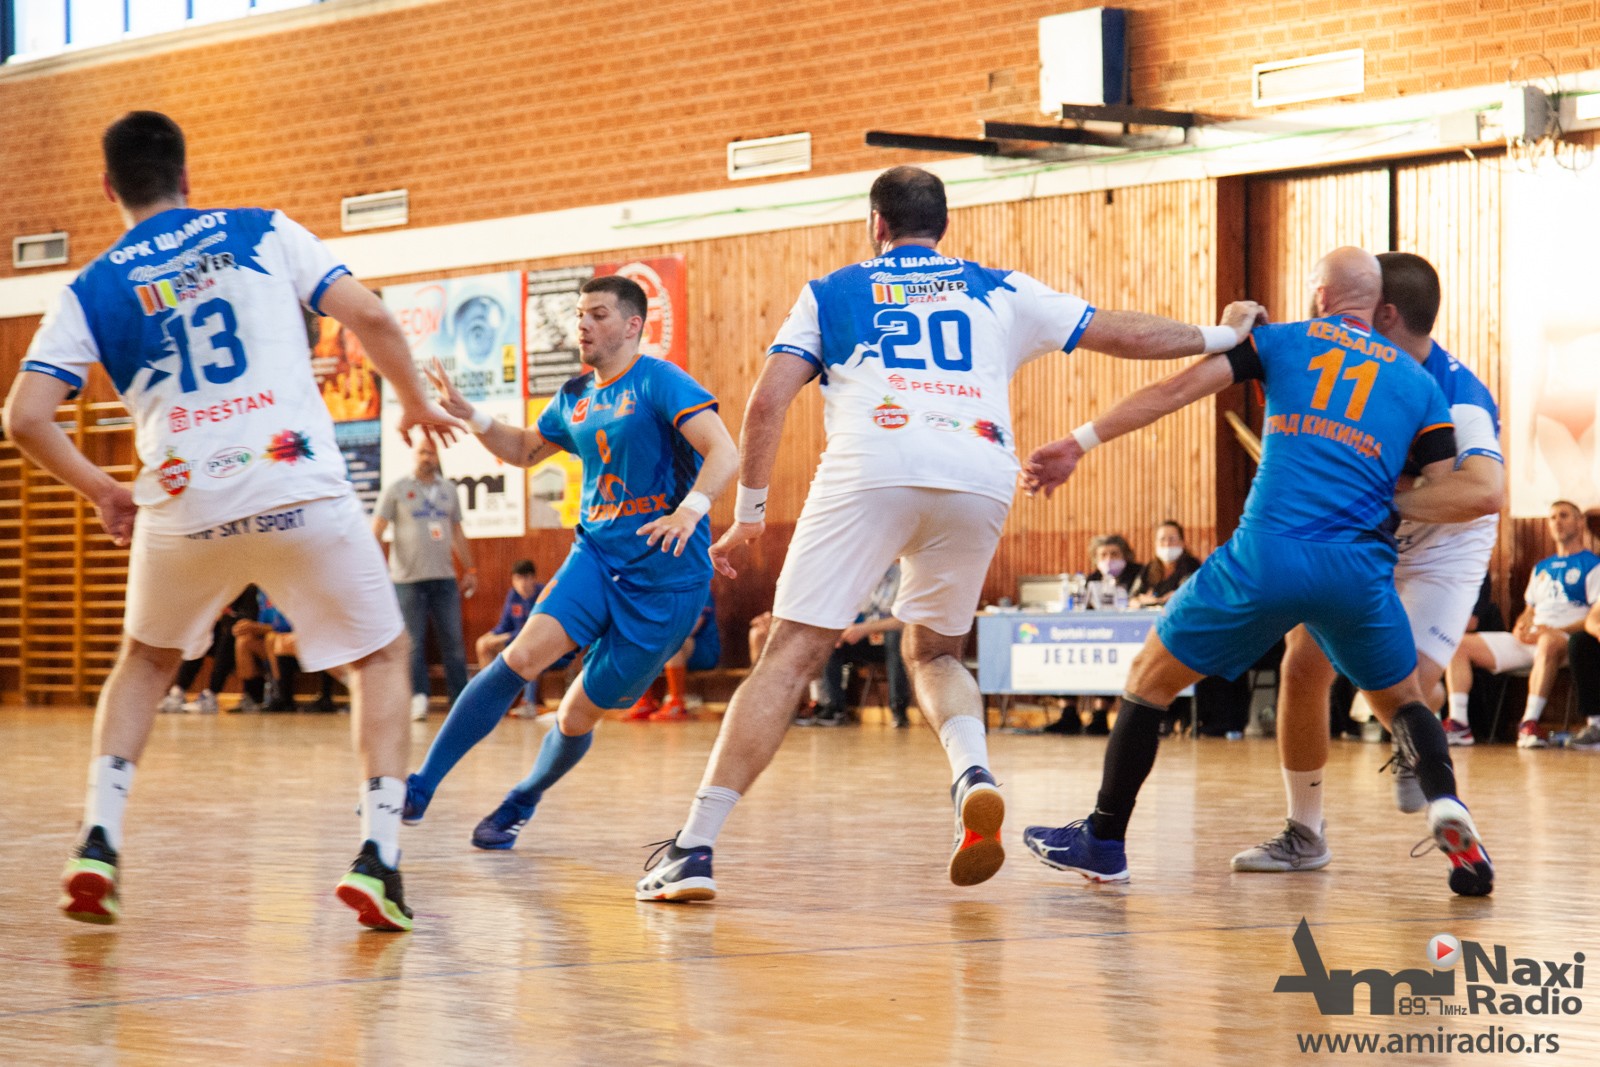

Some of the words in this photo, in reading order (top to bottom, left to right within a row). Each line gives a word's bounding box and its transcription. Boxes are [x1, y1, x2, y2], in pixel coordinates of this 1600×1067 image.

[108, 240, 155, 265] ОРК
[153, 211, 227, 252] ШАМОТ
[860, 257, 897, 268] ОРК
[901, 256, 965, 268] ШАМОТ
[906, 281, 965, 294] UNIVER
[165, 297, 247, 393] 13
[876, 309, 972, 371] 20
[1306, 320, 1398, 363] КЕЊАЛО
[911, 380, 982, 399] PEŠTAN
[1307, 347, 1380, 421] 11
[193, 390, 275, 427] PEŠTAN
[595, 429, 612, 464] 8
[255, 508, 306, 534] SPORT
[1043, 648, 1118, 665] JEZERO
